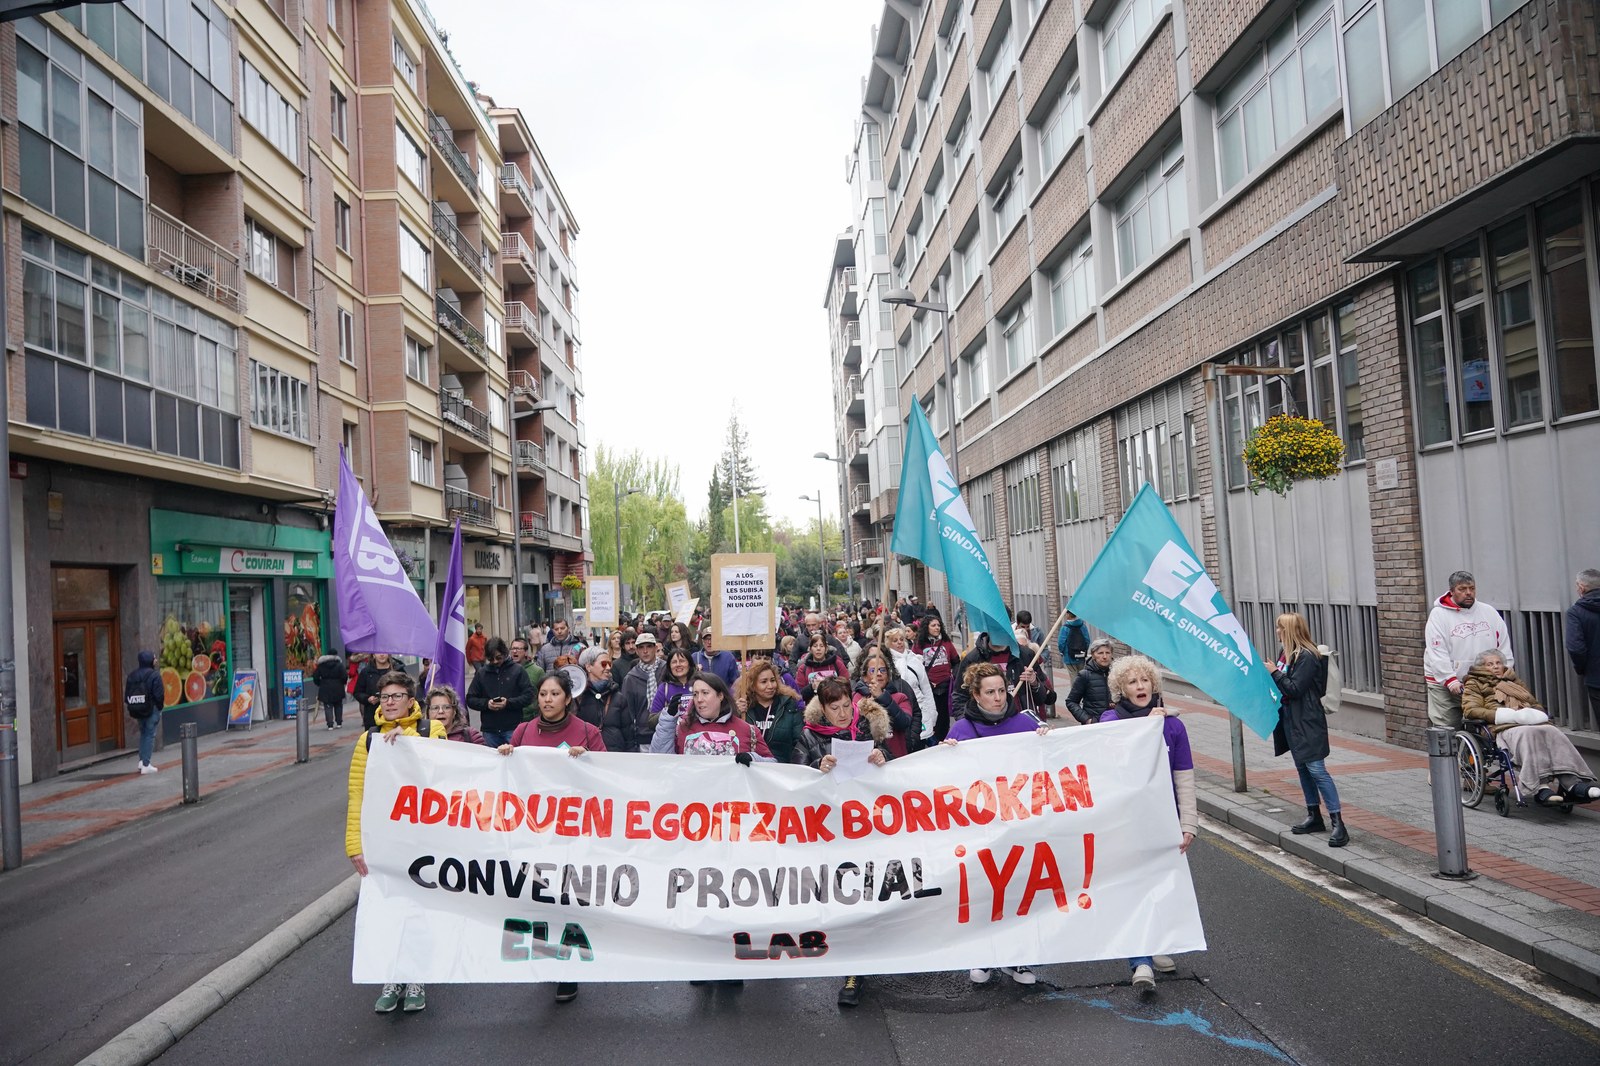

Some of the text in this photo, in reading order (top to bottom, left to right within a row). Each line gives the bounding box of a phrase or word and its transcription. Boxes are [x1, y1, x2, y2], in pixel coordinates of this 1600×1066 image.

[245, 557, 285, 571] COVIRAN
[1142, 539, 1253, 666] ELA
[1131, 590, 1250, 677] EUSKAL SINDIKATUA
[127, 695, 146, 704] VANS
[390, 764, 1095, 845] ADINDUEN EGOITZAK BORROKAN
[408, 833, 1096, 924] CONVENIO PROVINCIAL ¡YA!
[501, 917, 830, 962] ELA LAB
